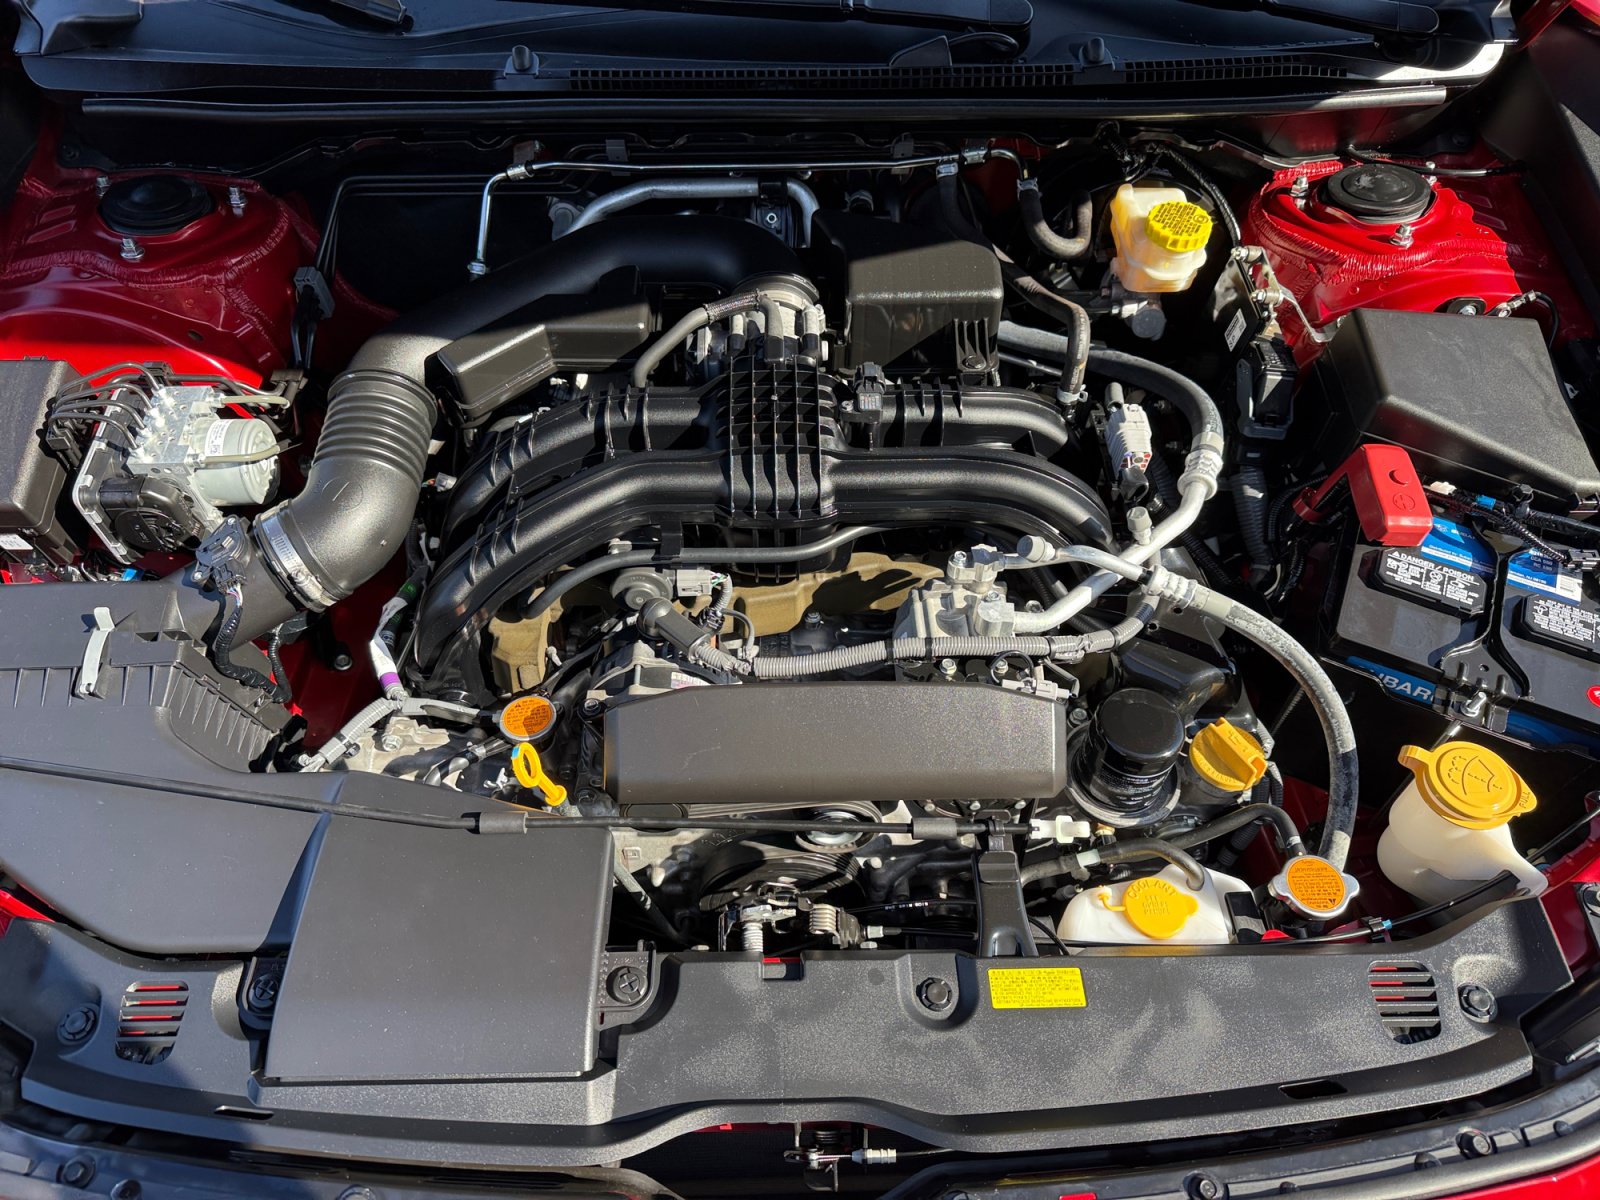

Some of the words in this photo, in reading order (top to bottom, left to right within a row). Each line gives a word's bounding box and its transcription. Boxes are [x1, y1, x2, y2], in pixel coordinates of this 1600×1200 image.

[1401, 553, 1435, 569] DANGER
[1442, 566, 1475, 582] POISON
[1371, 668, 1434, 702] BAR
[1519, 791, 1531, 809] FULL
[1127, 879, 1178, 899] COOLANT
